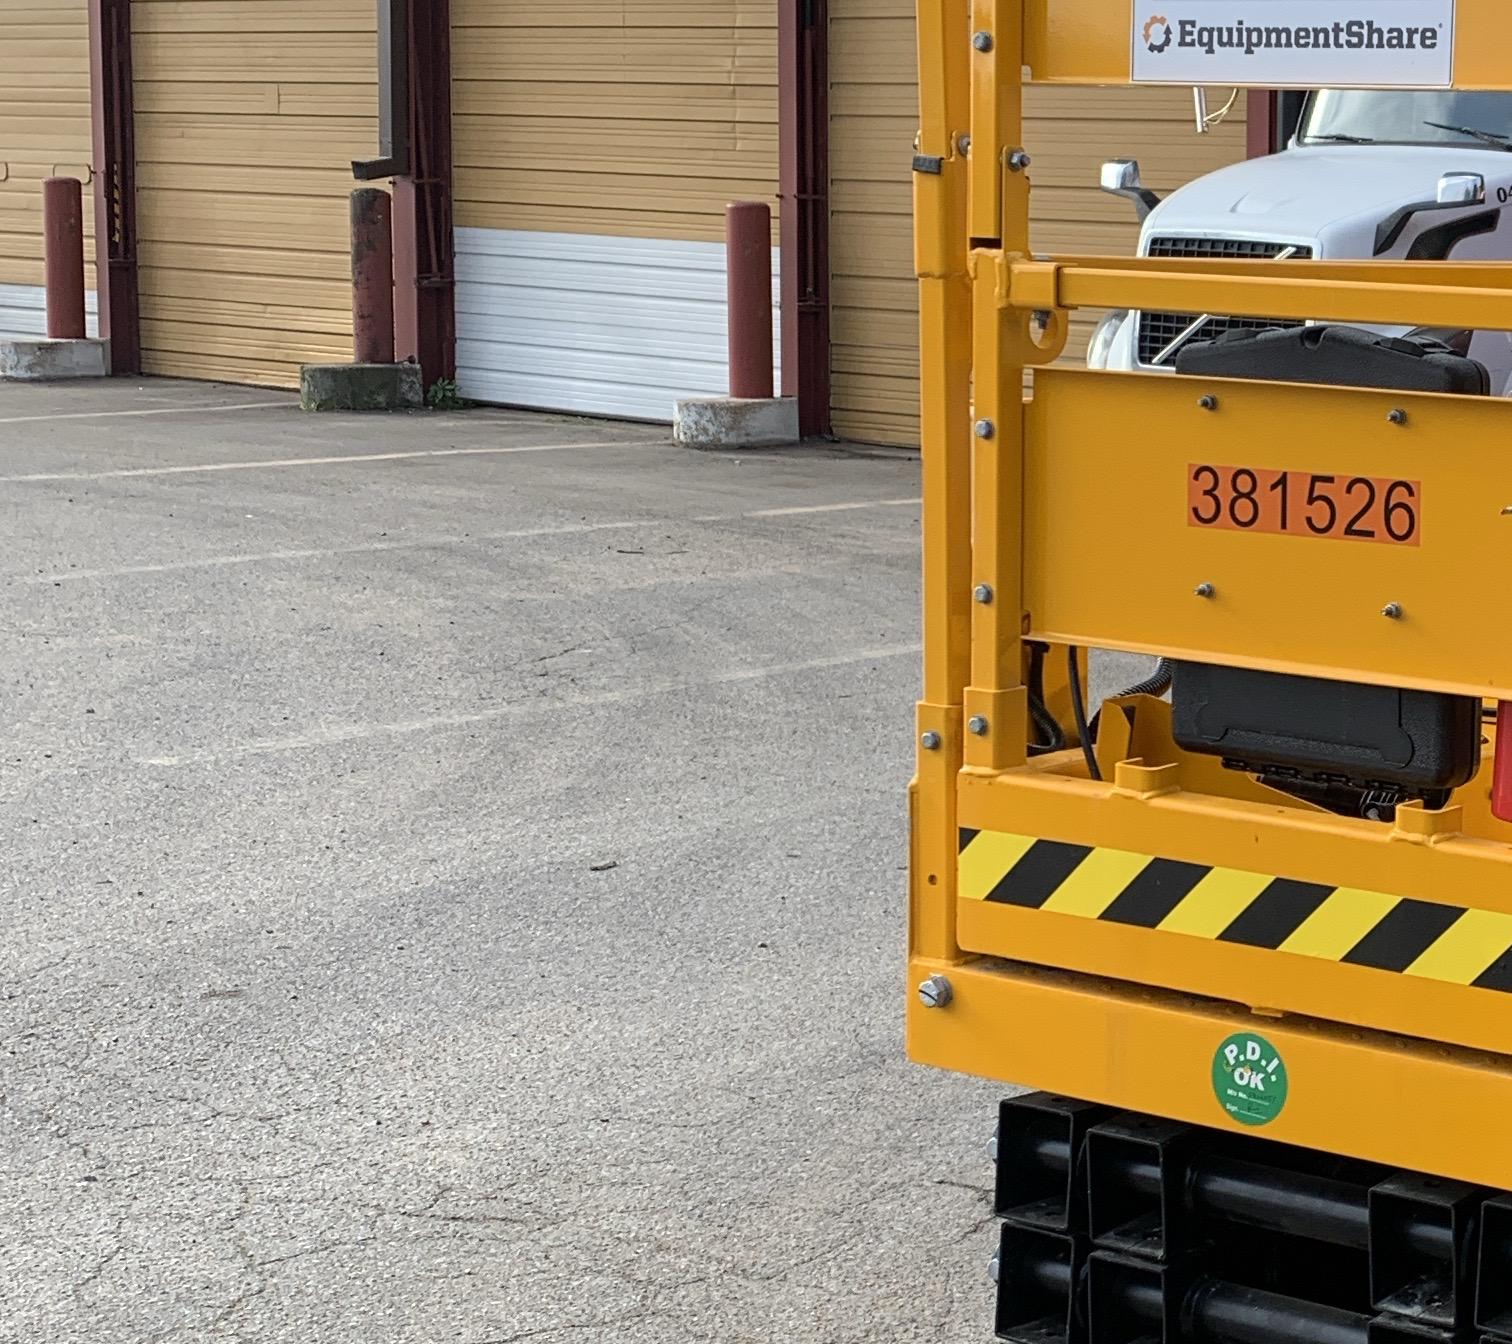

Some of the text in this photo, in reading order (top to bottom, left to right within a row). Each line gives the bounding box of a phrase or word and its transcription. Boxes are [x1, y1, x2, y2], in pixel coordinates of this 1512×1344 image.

[1177, 19, 1438, 54] EquipmentShare
[1192, 465, 1415, 542] 381526
[1233, 1067, 1265, 1091] OK
